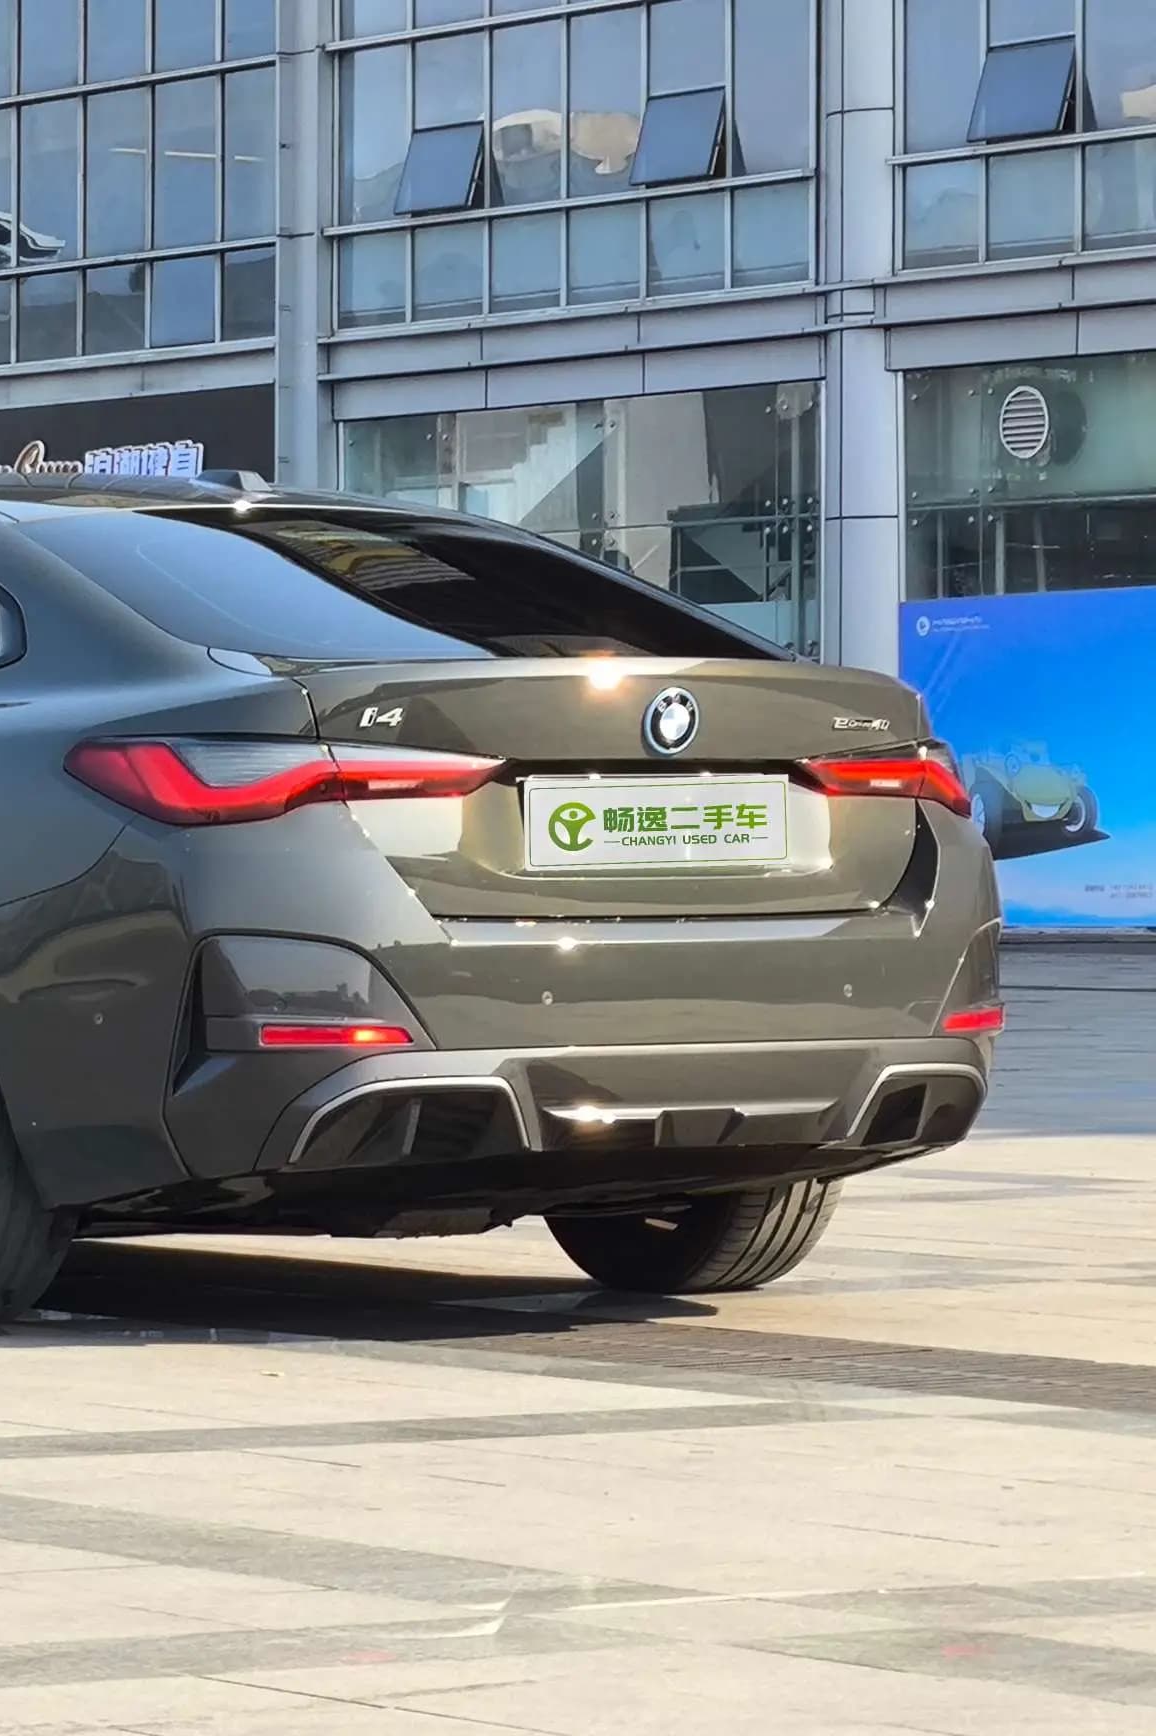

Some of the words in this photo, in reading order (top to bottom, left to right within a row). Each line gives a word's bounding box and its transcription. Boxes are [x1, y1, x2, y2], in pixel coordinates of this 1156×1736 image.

[359, 707, 404, 728] i4
[602, 803, 768, 833] 畅逸二手车
[620, 835, 676, 846] CHANGYI
[682, 834, 717, 845] USED
[723, 833, 750, 844] CAR
